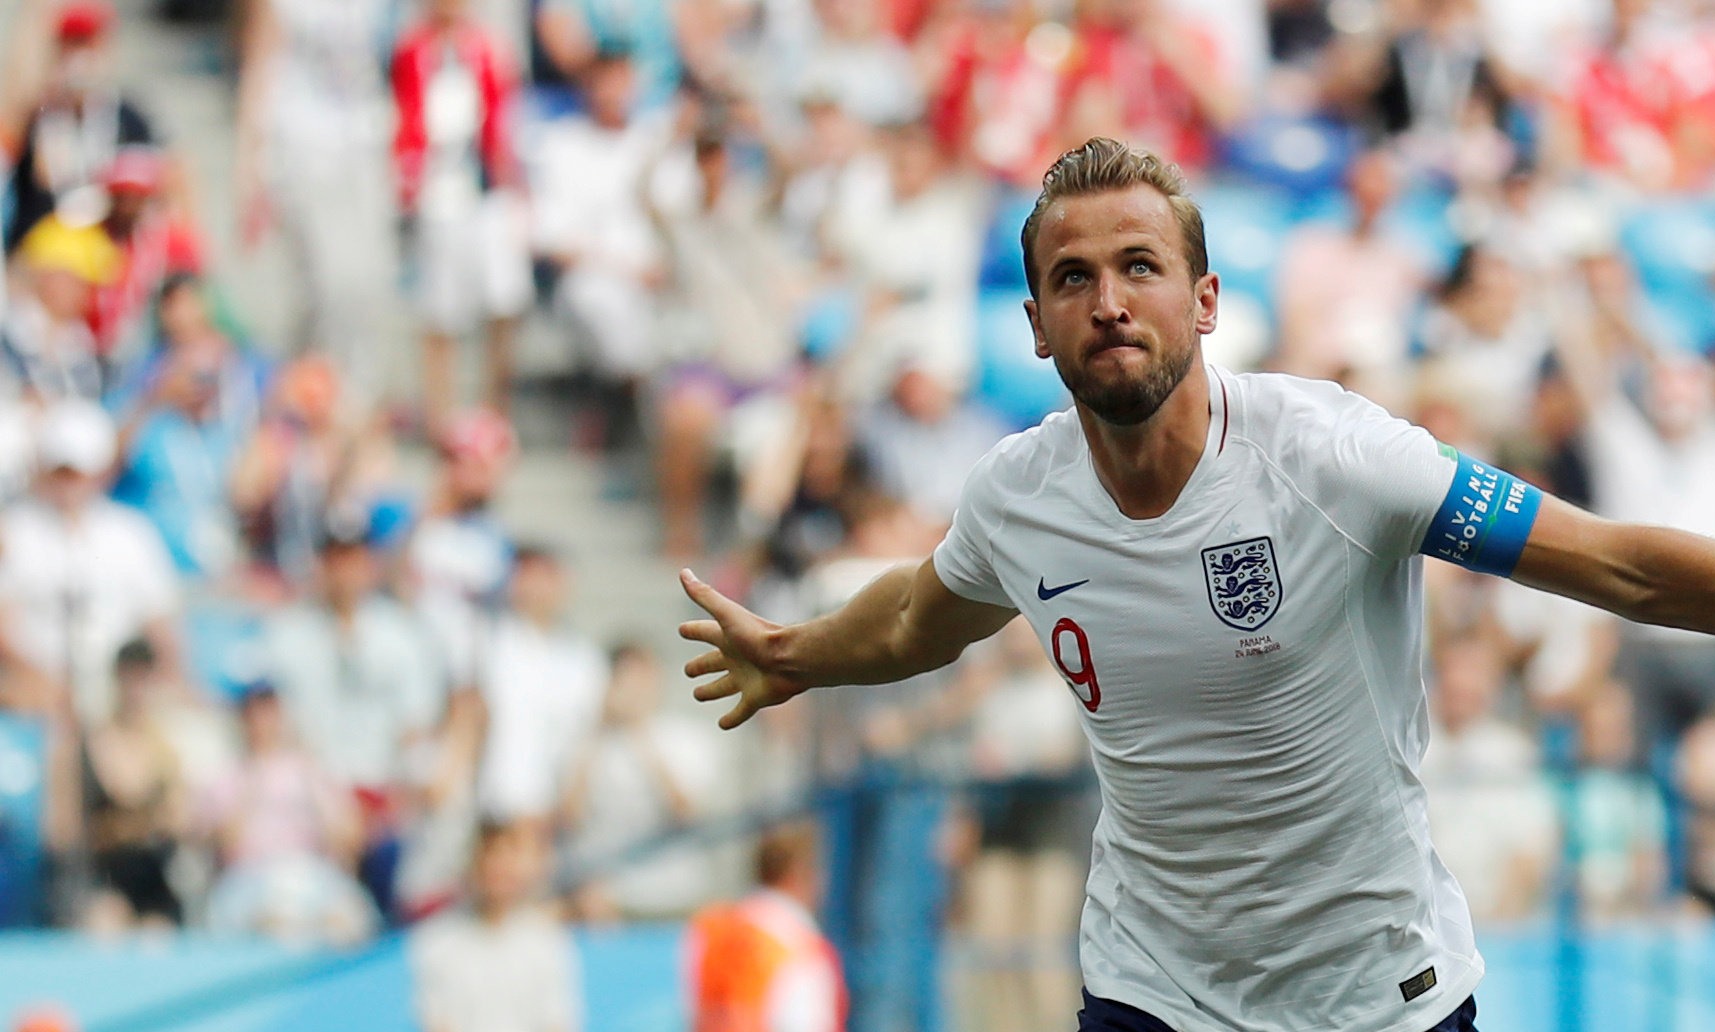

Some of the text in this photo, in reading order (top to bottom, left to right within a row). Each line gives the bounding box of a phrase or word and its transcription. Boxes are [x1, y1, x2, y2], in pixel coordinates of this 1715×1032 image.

[1439, 463, 1486, 555] LIVING
[1453, 472, 1499, 561] FOOTBALL
[1505, 481, 1527, 514] FIFA
[1051, 617, 1101, 713] 9
[1239, 635, 1272, 648] PANAMA
